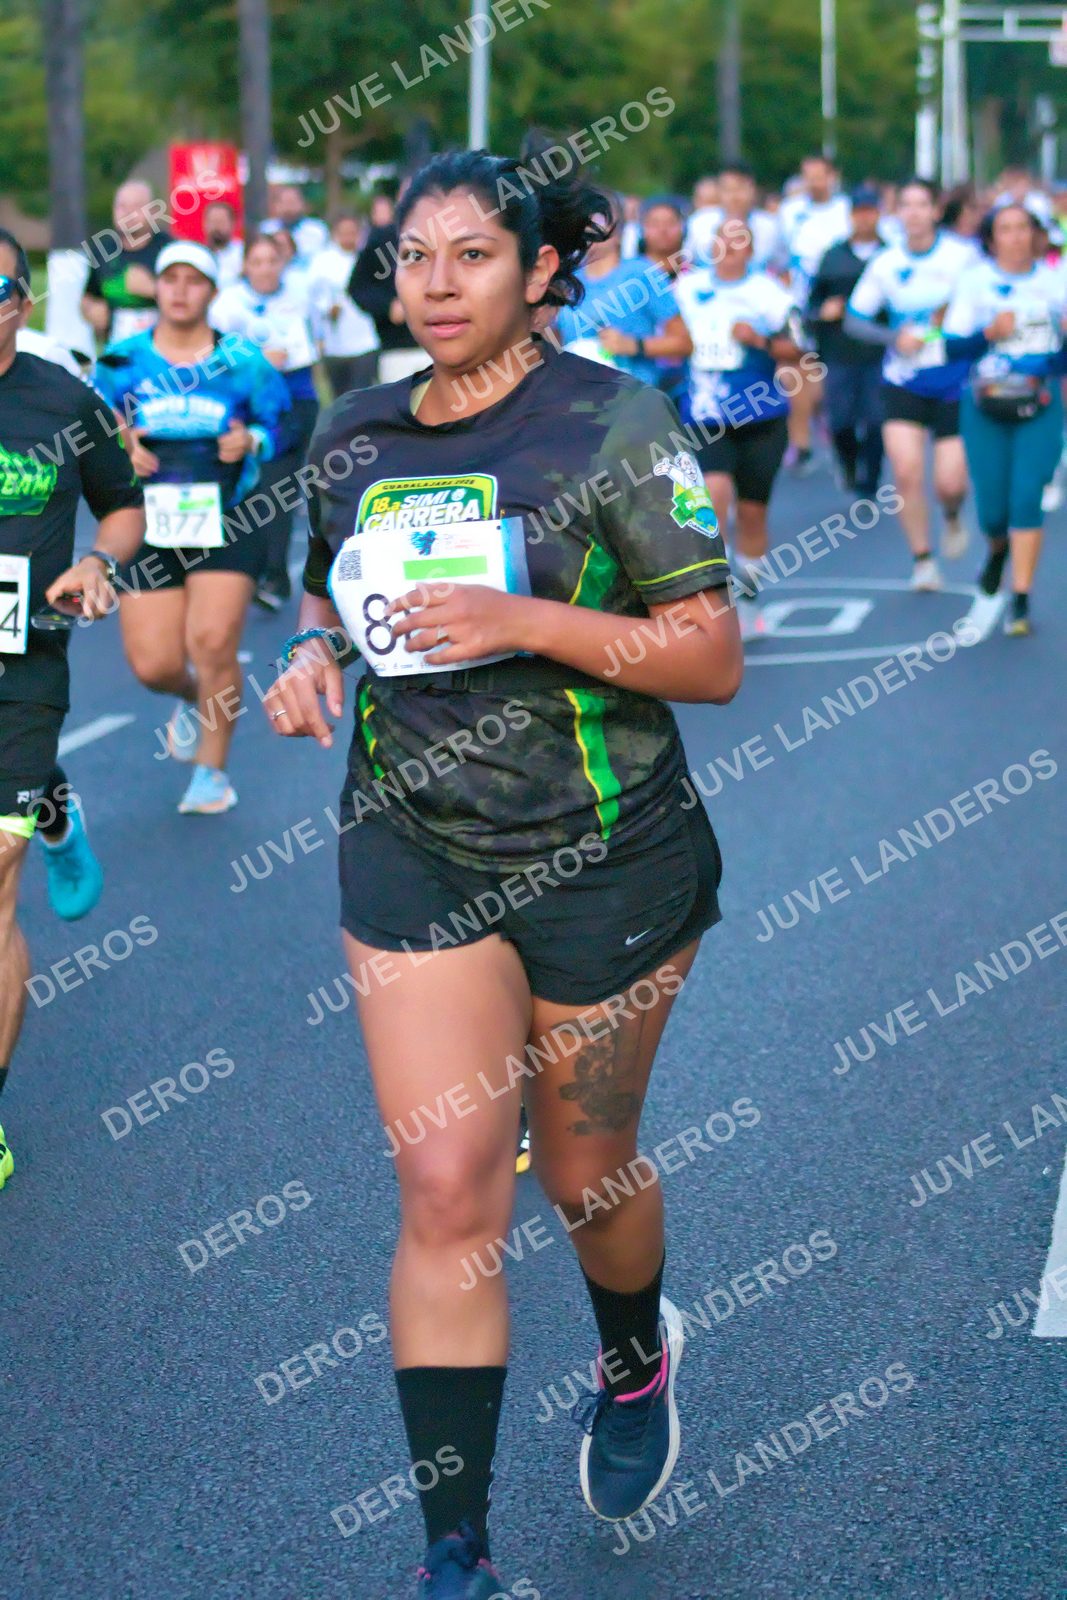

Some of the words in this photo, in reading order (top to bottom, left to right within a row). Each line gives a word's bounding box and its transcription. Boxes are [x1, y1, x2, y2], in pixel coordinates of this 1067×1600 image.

[401, 490, 451, 509] SIMI
[156, 512, 207, 537] 877
[363, 499, 481, 531] CARRERA
